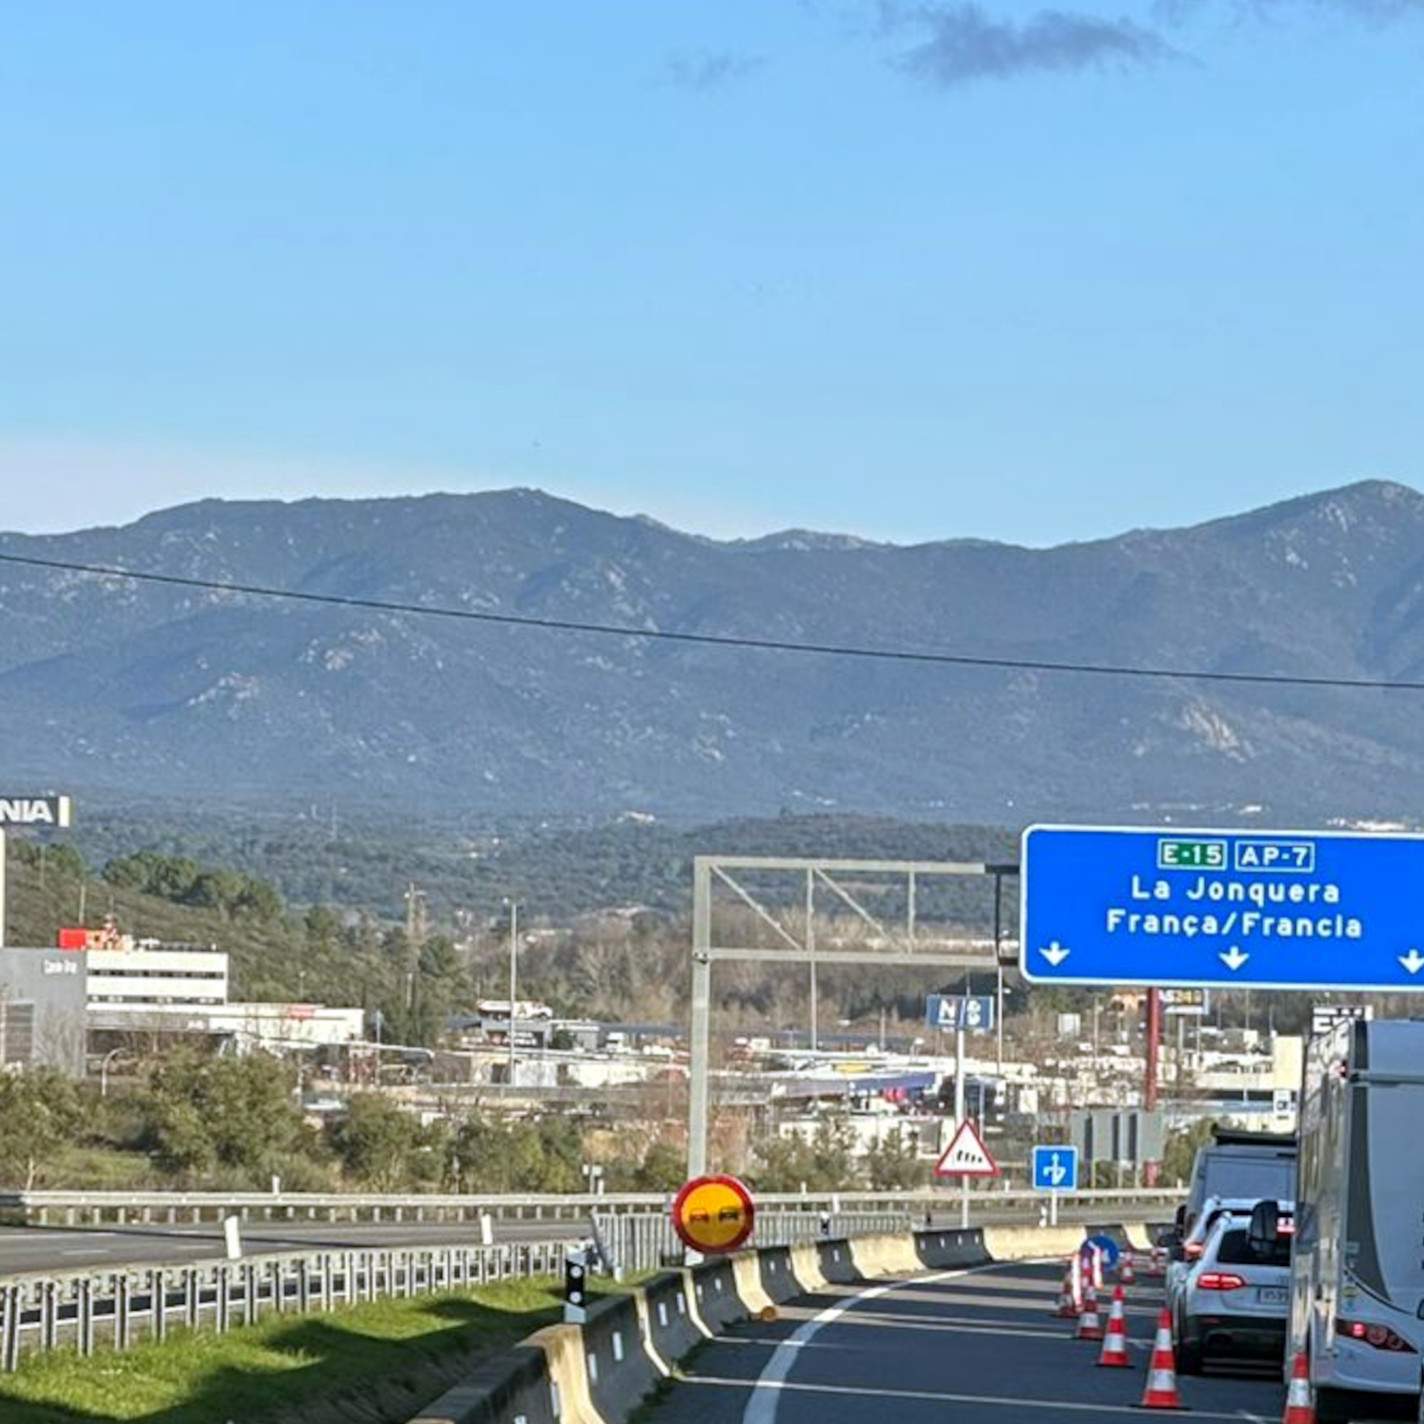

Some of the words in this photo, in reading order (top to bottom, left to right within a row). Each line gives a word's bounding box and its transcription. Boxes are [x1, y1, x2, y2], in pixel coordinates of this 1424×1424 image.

[1162, 844, 1223, 865] E-15
[1240, 845, 1309, 867] AP-7
[1131, 874, 1171, 900] La
[1186, 876, 1340, 908] Jonquera
[1106, 908, 1362, 937] França/Francia
